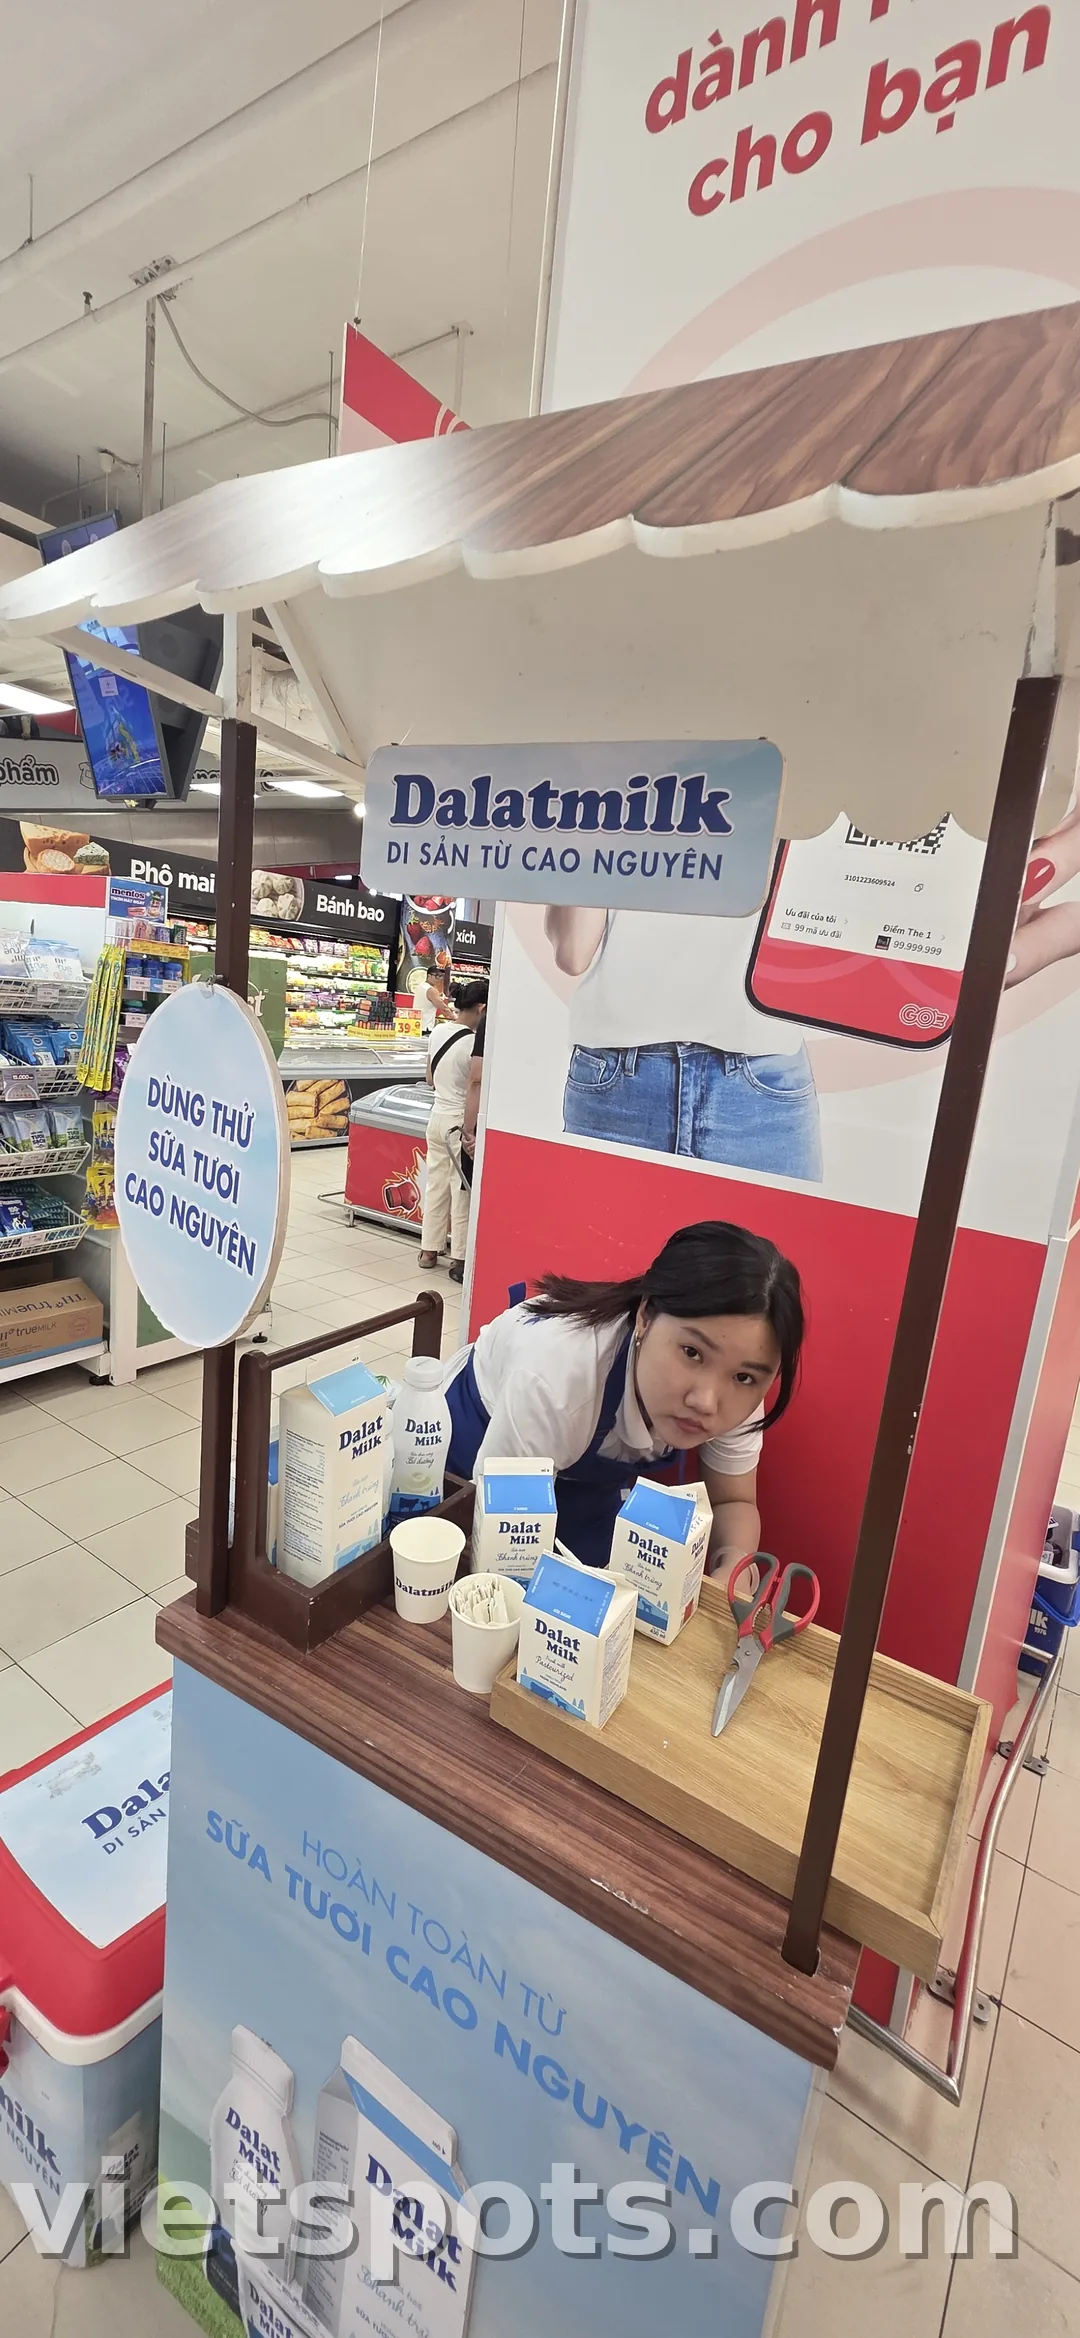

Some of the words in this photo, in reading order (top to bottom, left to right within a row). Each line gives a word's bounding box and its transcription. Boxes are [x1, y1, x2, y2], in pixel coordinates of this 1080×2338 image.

[688, 111, 833, 216] cho
[860, 4, 1051, 145] bạn
[389, 773, 733, 833] Dalatmilk
[387, 841, 409, 865] DI
[419, 835, 468, 868] SẢN
[480, 839, 512, 869] TỪ
[521, 846, 580, 873] CAO
[593, 846, 723, 881] NGUYÊN
[131, 859, 173, 887] Phô
[178, 871, 215, 894] mai
[844, 874, 896, 887] 3101223609524
[111, 888, 146, 899] mentos
[316, 895, 354, 919] Bánh
[357, 902, 385, 923] bao
[810, 912, 825, 921] của
[825, 914, 837, 924] tôi
[456, 930, 476, 945] xích
[794, 923, 805, 932] 99
[805, 925, 818, 934] mã
[883, 923, 905, 935] Điểm
[907, 927, 925, 938] The
[926, 931, 932, 939] 1
[892, 940, 943, 956] 99.999.999
[398, 1022, 411, 1033] 39
[147, 1073, 206, 1127] DÙNG
[211, 1102, 255, 1148] THỬ
[148, 1130, 186, 1176] SỮA
[193, 1151, 241, 1204] TƯƠI
[125, 1173, 165, 1216] CAO
[169, 1195, 257, 1276] NGUYÊN
[339, 1415, 383, 1451] Dalat
[405, 1418, 442, 1434] Dalat
[351, 1435, 382, 1460] Milk
[415, 1435, 442, 1446] Milk
[498, 1521, 541, 1534] Dalat
[509, 1535, 540, 1544] Milk
[627, 1530, 669, 1559] Dalat
[637, 1549, 666, 1570] Milk
[534, 1618, 581, 1652] Dalat
[546, 1640, 579, 1665] Milk
[102, 1836, 124, 1855] DI
[127, 1807, 167, 1838] SẢN
[301, 1829, 397, 1921] HOÀN
[407, 1900, 508, 2000] TOÀN
[519, 1981, 568, 2037] TỪ
[205, 1809, 273, 1883] SỮA
[284, 1864, 373, 1956] TƯƠI
[385, 1944, 479, 2031] CAO
[493, 2018, 722, 2218] NGUYÊN
[225, 2107, 281, 2173] Dalat
[238, 2139, 281, 2193] Milk
[365, 2153, 463, 2265] Dalat
